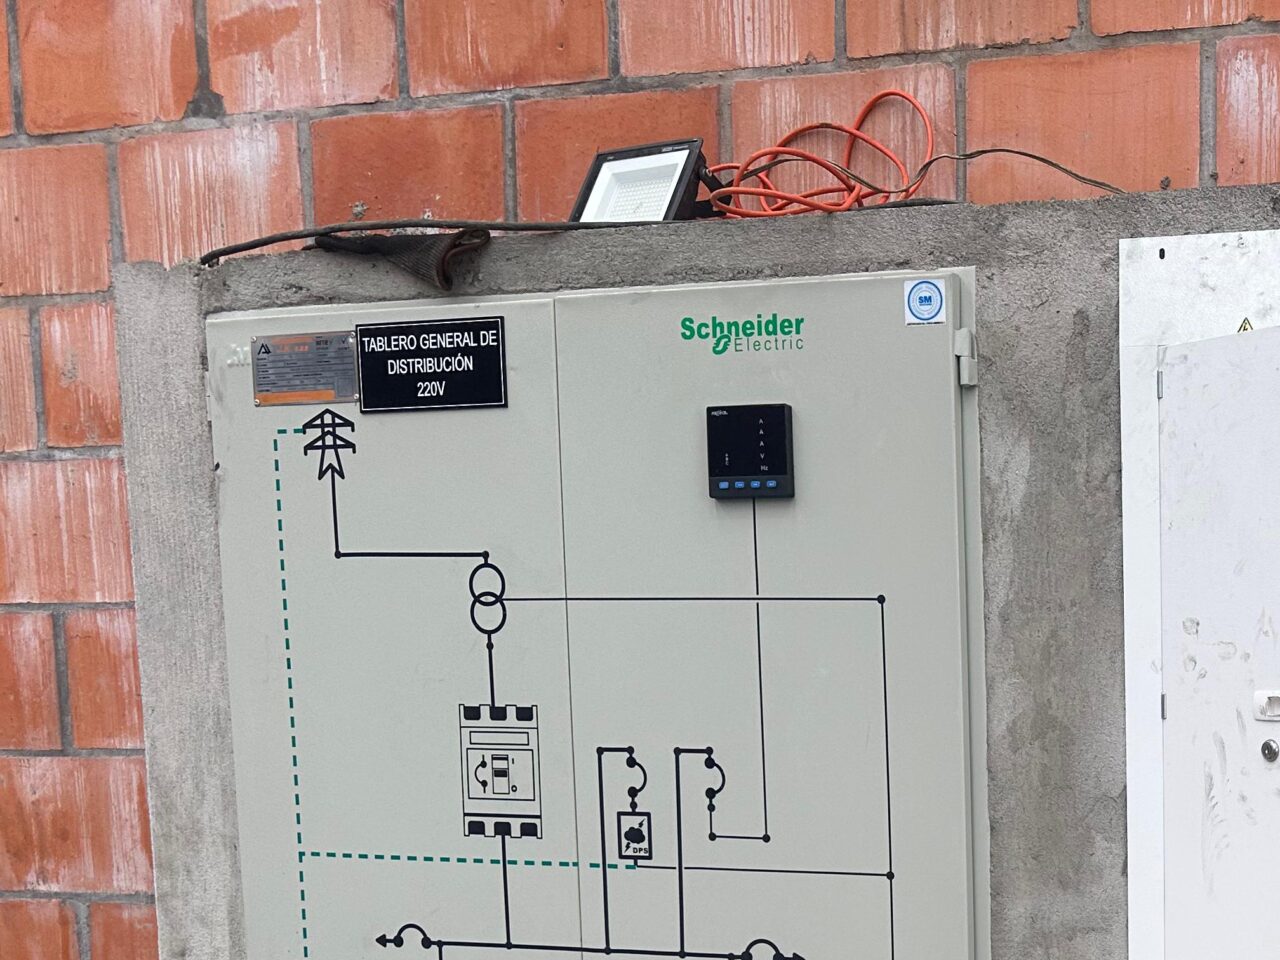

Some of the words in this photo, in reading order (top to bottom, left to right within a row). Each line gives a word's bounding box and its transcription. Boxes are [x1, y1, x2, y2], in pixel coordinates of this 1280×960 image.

[681, 313, 804, 340] Schneider
[362, 335, 417, 353] TABLERO
[419, 332, 477, 350] GENERAL
[480, 330, 497, 346] DE
[734, 336, 804, 352] Electric
[388, 353, 473, 375] DISTRIBUCIÓN
[417, 381, 446, 397] 220V
